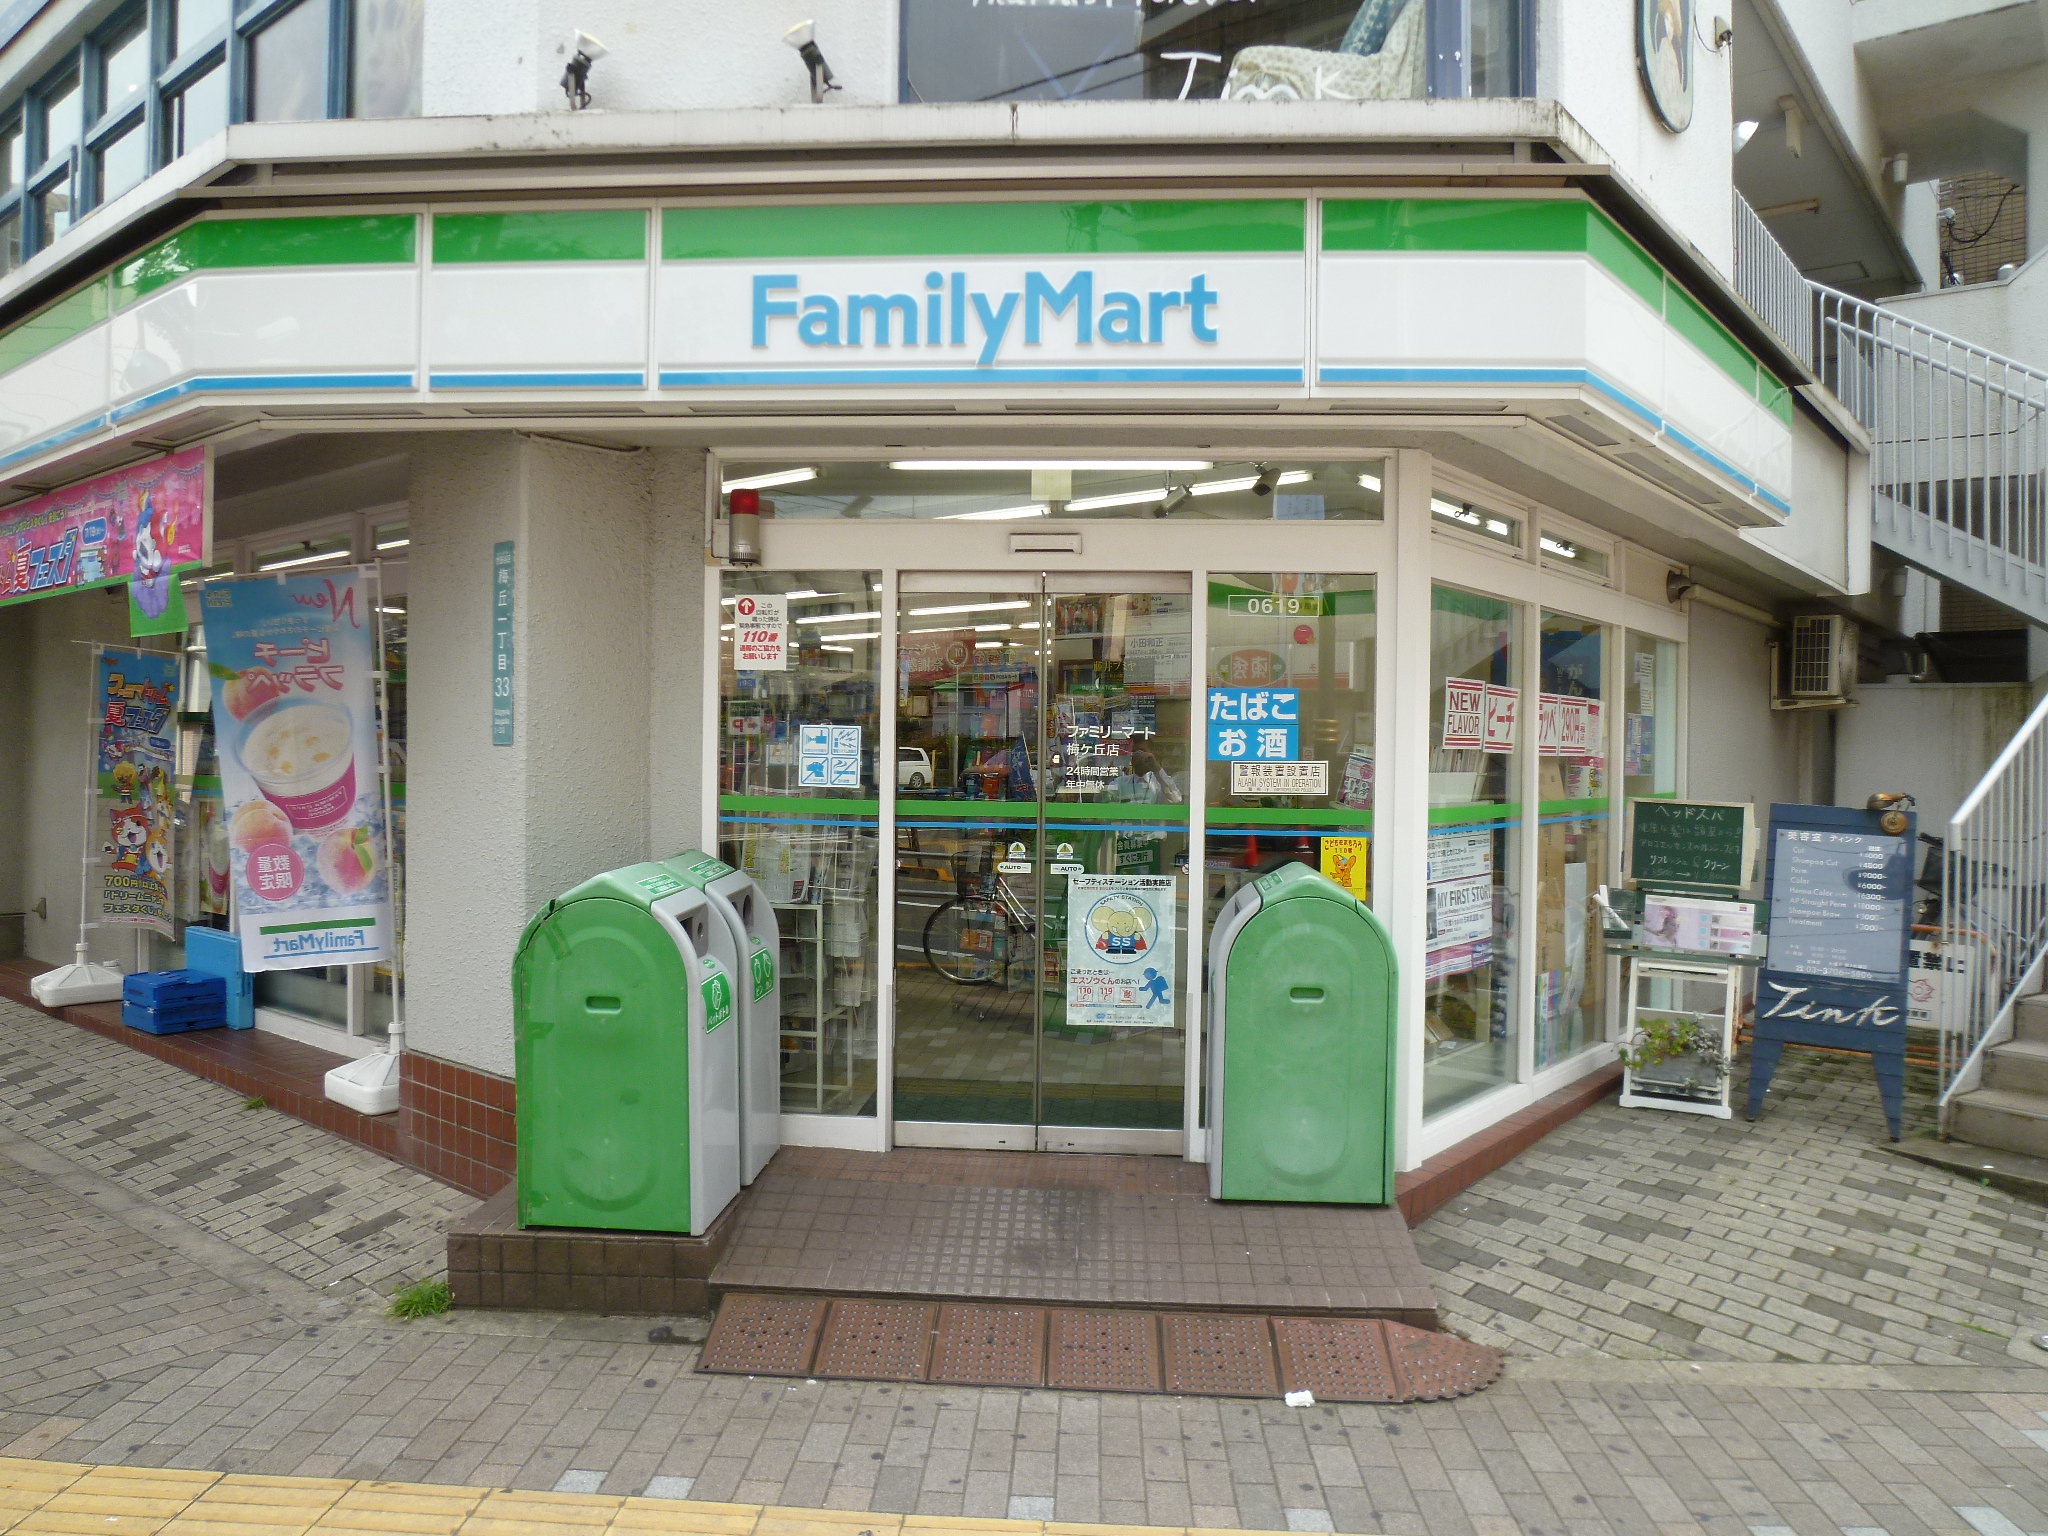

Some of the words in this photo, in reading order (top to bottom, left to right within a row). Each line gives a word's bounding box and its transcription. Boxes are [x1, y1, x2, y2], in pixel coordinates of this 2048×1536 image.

[751, 270, 1217, 365] FamilyMart
[1248, 599, 1299, 613] 0619
[743, 631, 778, 642] 110番
[495, 677, 509, 697] 33
[1210, 691, 1296, 721] たばこ
[1450, 692, 1480, 711] NEW
[1447, 714, 1480, 734] FLAVOR
[1487, 697, 1515, 739] ピーチ
[1066, 725, 1156, 740] ファミリーマート
[1218, 728, 1288, 758] お酒
[1066, 766, 1119, 776] 24時間営業
[1065, 780, 1105, 789] 年中無休
[1238, 778, 1257, 787] ALARM
[1259, 777, 1281, 787] SYSTEM
[1283, 778, 1290, 787] IN
[1291, 778, 1322, 788] OPERATION
[1656, 806, 1723, 820] ヘッドスパ
[1787, 831, 1822, 842] 美容室
[1829, 834, 1862, 843] ティンク
[1792, 857, 1824, 866] Shampoo
[1438, 892, 1448, 909] MY
[1449, 887, 1470, 906] FIRST
[1813, 889, 1833, 897] Color
[1121, 895, 1144, 906] STATION
[1801, 899, 1828, 907] Straight
[1829, 900, 1846, 908] Perm
[1788, 907, 1821, 916] Shampoo
[1788, 918, 1822, 926] Treatment
[1112, 938, 1131, 947] SS
